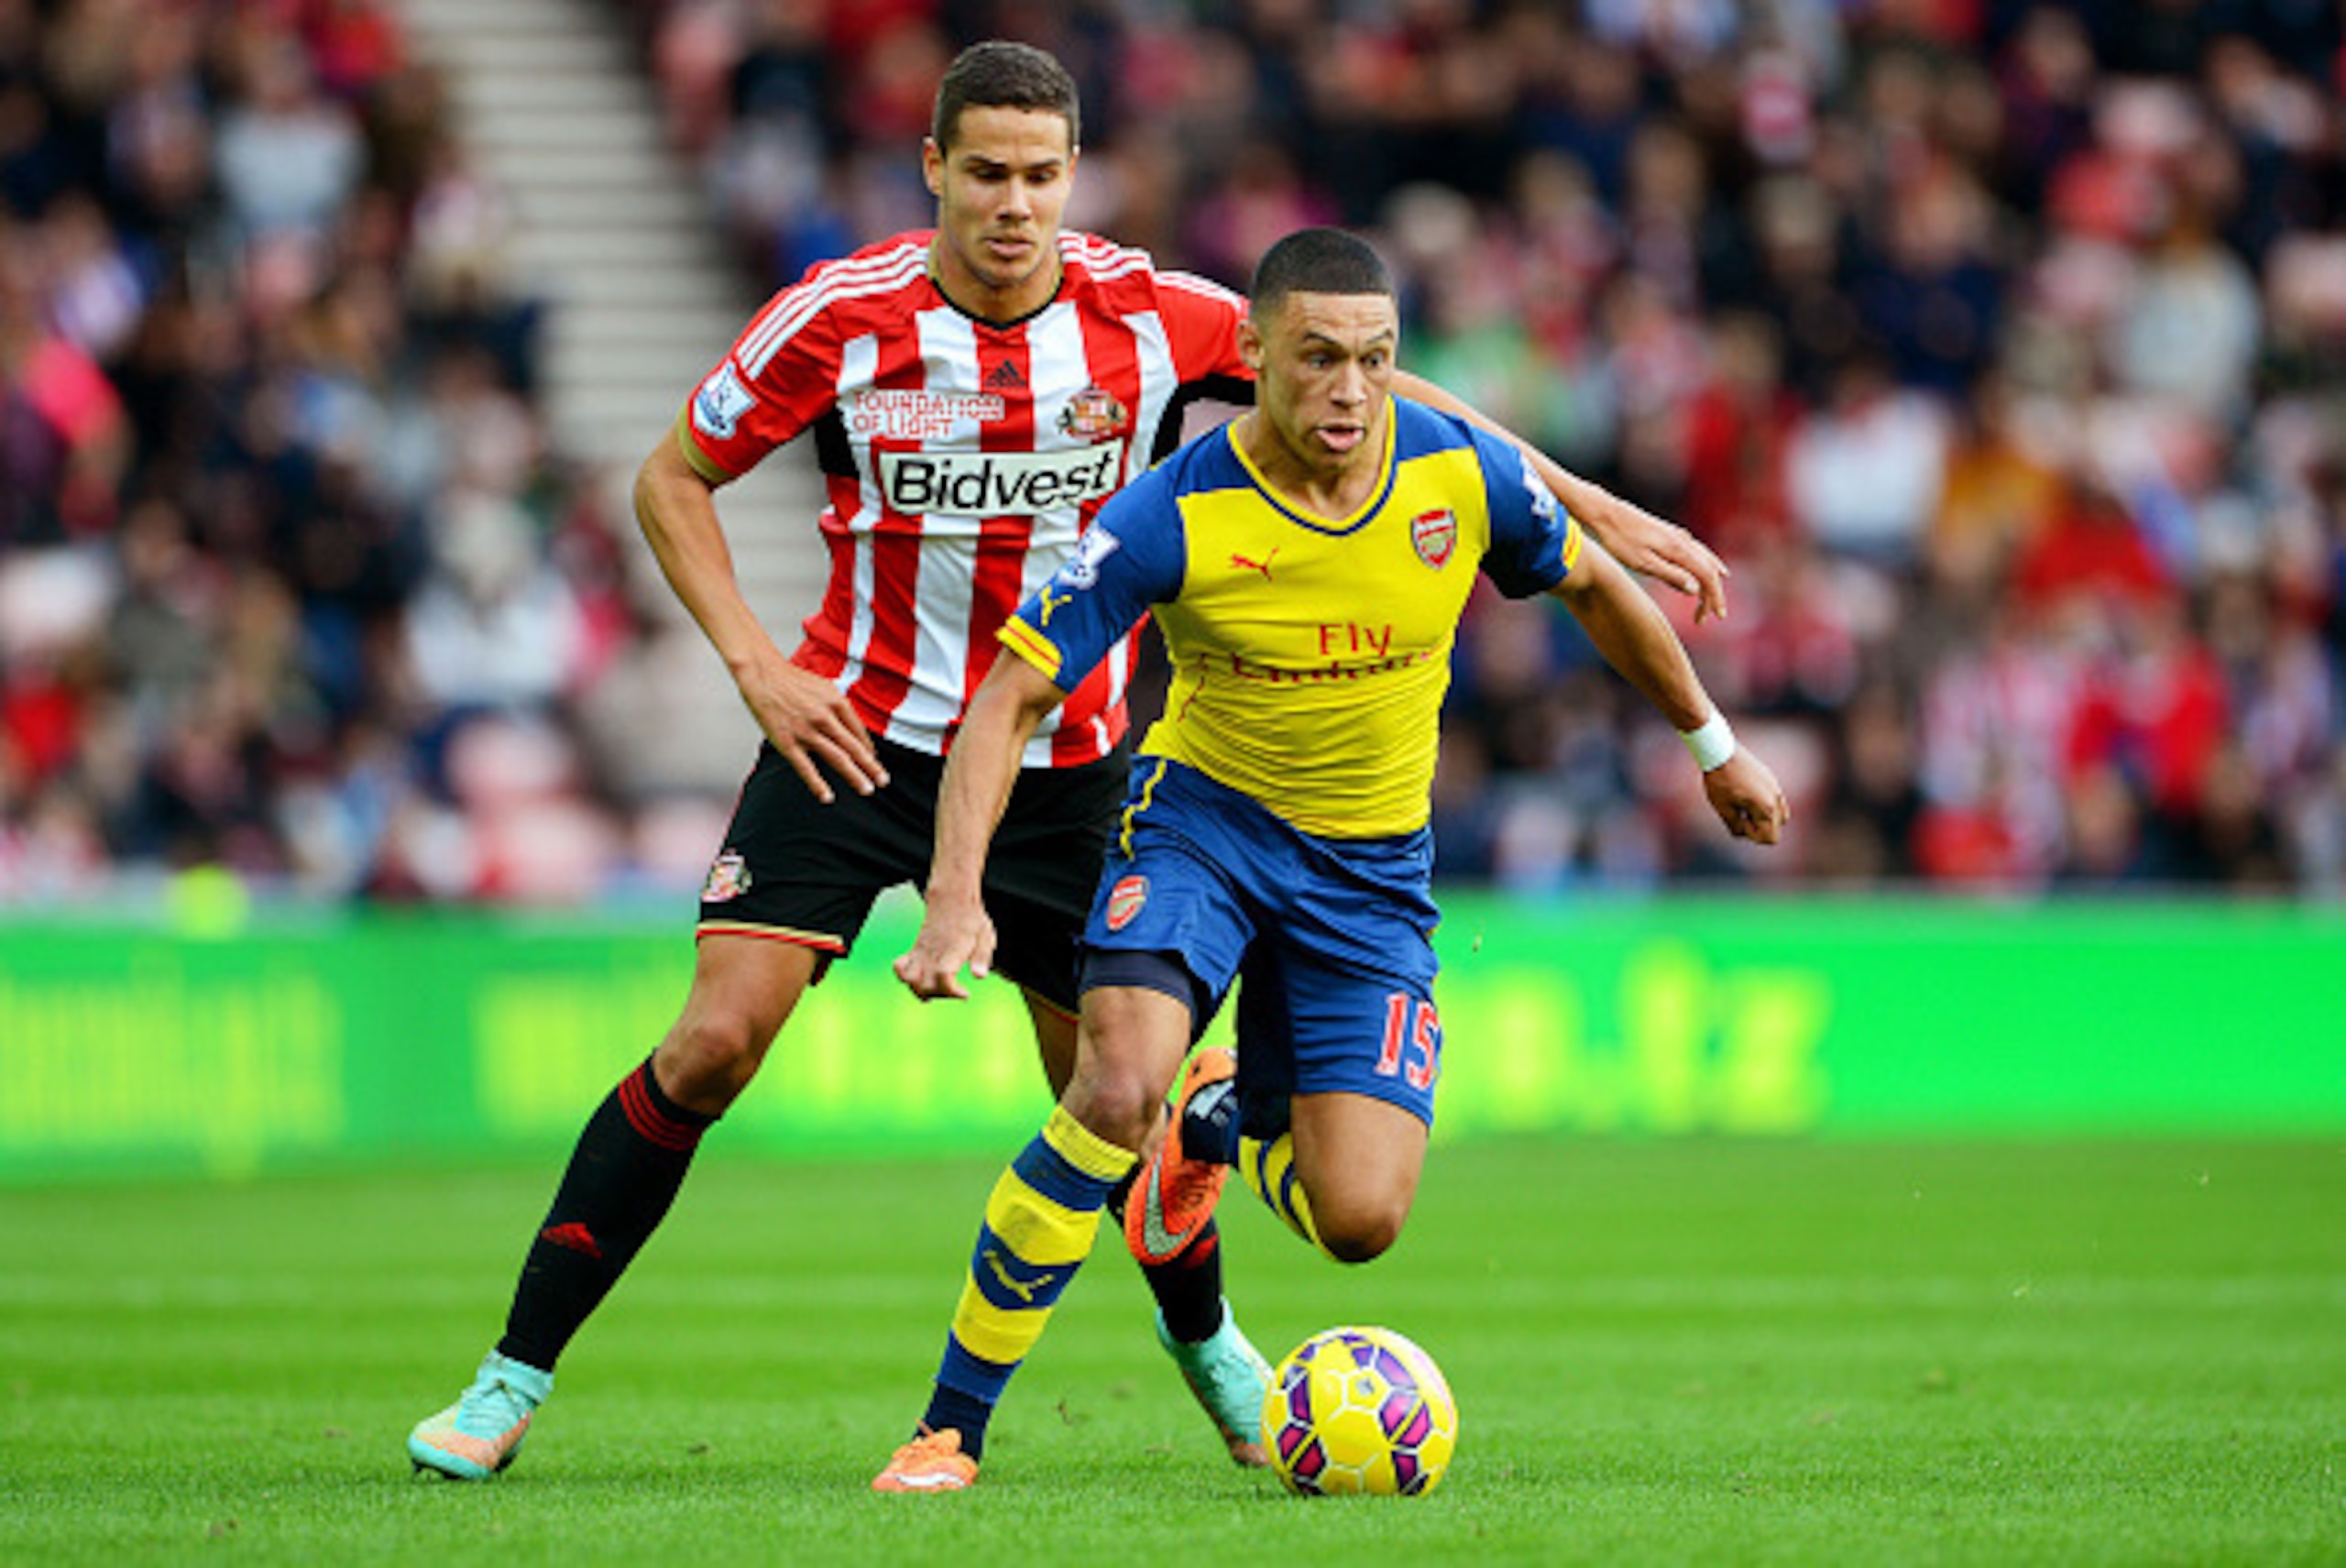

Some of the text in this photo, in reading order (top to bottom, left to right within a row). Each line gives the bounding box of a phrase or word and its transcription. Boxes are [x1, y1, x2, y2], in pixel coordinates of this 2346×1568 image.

[854, 391, 1000, 419] FOUNDATION
[853, 413, 954, 437] OF LIGHT
[893, 451, 1113, 509] Bidvest
[1320, 622, 1392, 657] Fly
[1375, 992, 1440, 1091] 15
